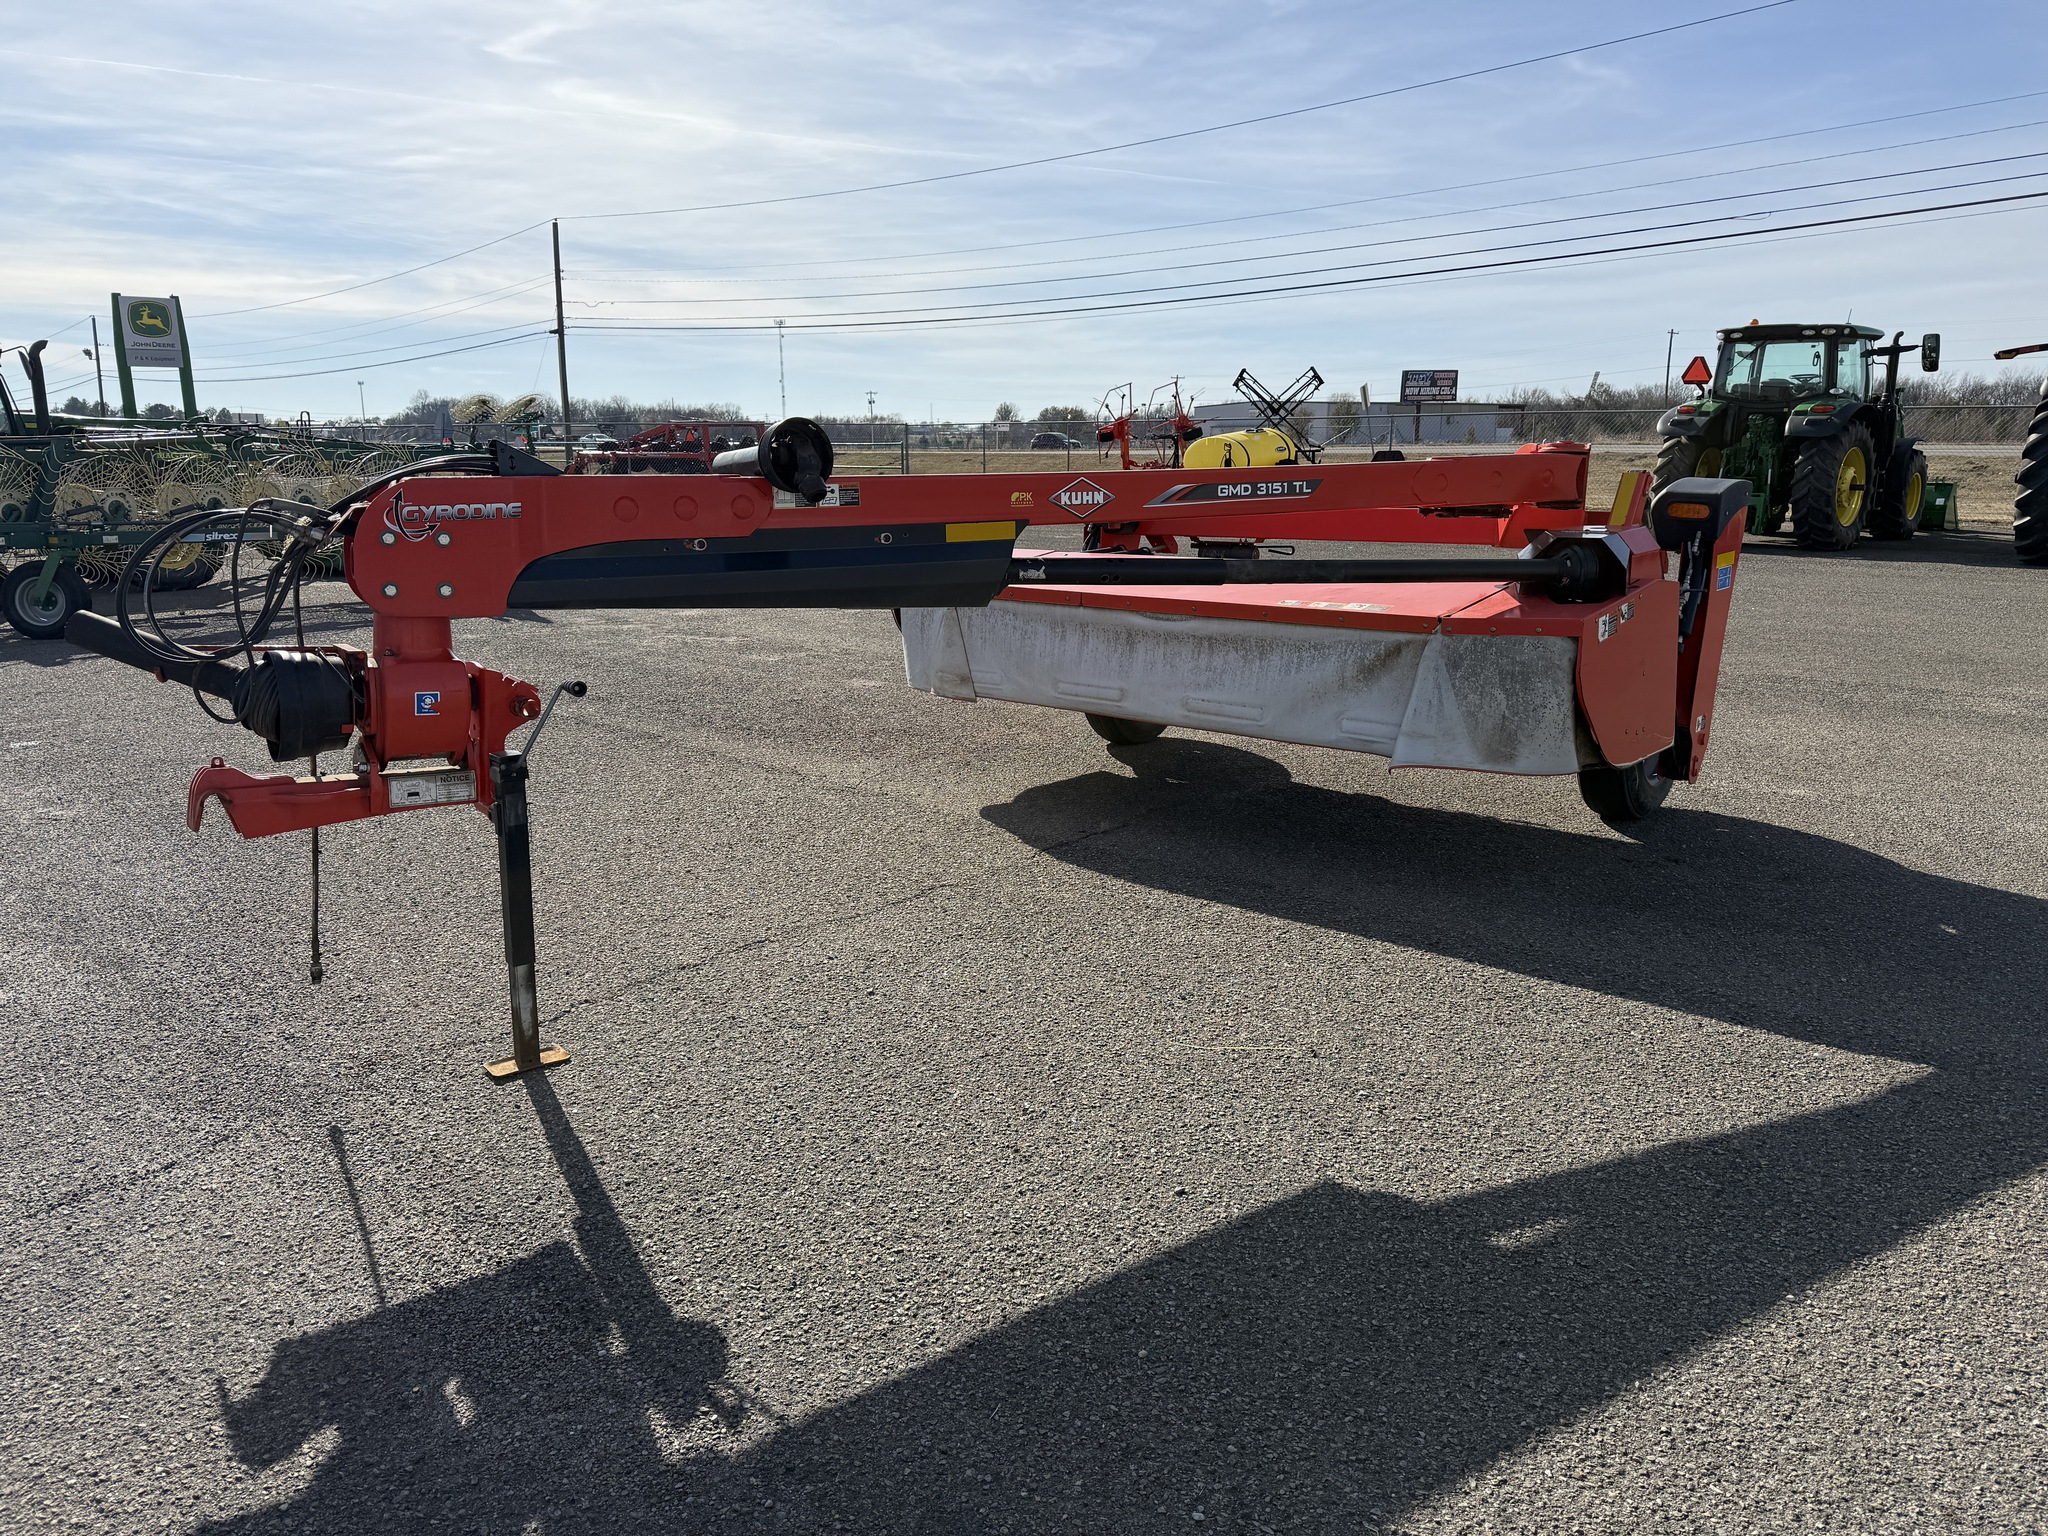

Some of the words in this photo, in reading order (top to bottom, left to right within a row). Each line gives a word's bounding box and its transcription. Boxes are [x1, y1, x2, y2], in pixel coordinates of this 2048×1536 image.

[152, 341, 176, 349] DEERE
[1405, 387, 1420, 396] NOW
[1420, 387, 1440, 395] HIRING
[1440, 386, 1456, 395] CDL-A
[1217, 484, 1252, 497] GMD
[1257, 482, 1288, 495] 3151
[1293, 481, 1312, 493] TL
[1060, 491, 1104, 506] KUHN
[401, 502, 522, 523] GYRODINE
[206, 532, 239, 541] sitrex
[440, 774, 470, 783] NOTICE
